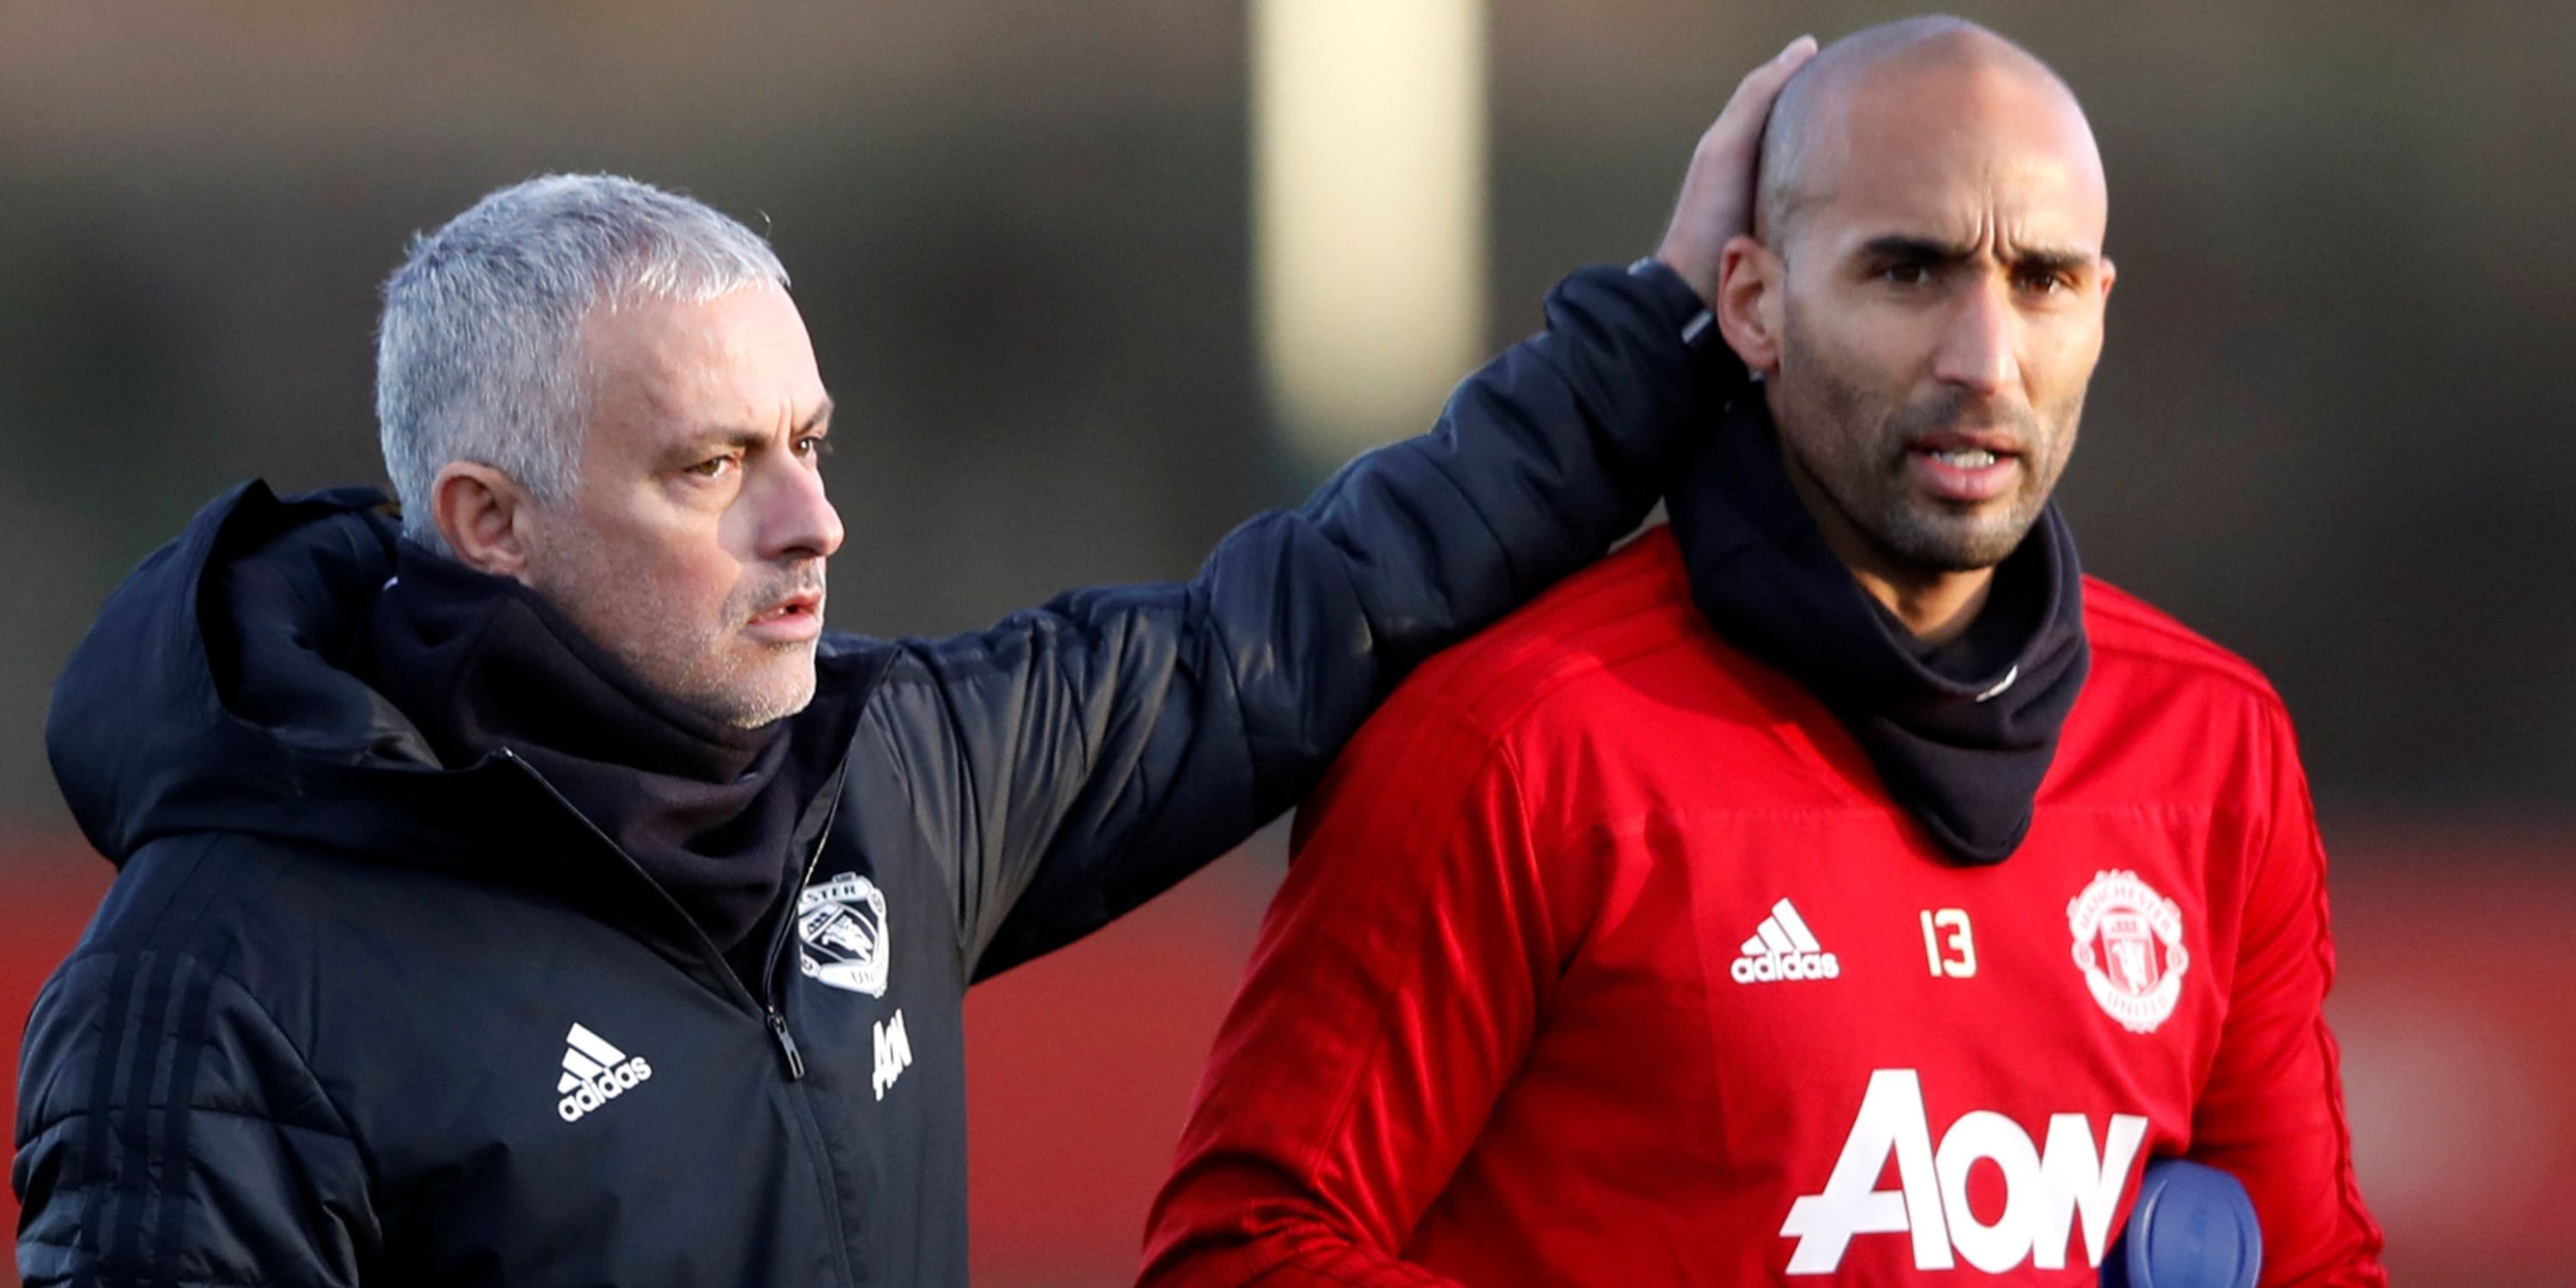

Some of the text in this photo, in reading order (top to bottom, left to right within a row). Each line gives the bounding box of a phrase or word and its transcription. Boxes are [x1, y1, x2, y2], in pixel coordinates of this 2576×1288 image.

[805, 884, 857, 902] STER
[1730, 949, 1840, 984] adidas
[1919, 908, 1978, 979] 13
[557, 1056, 653, 1122] adidas
